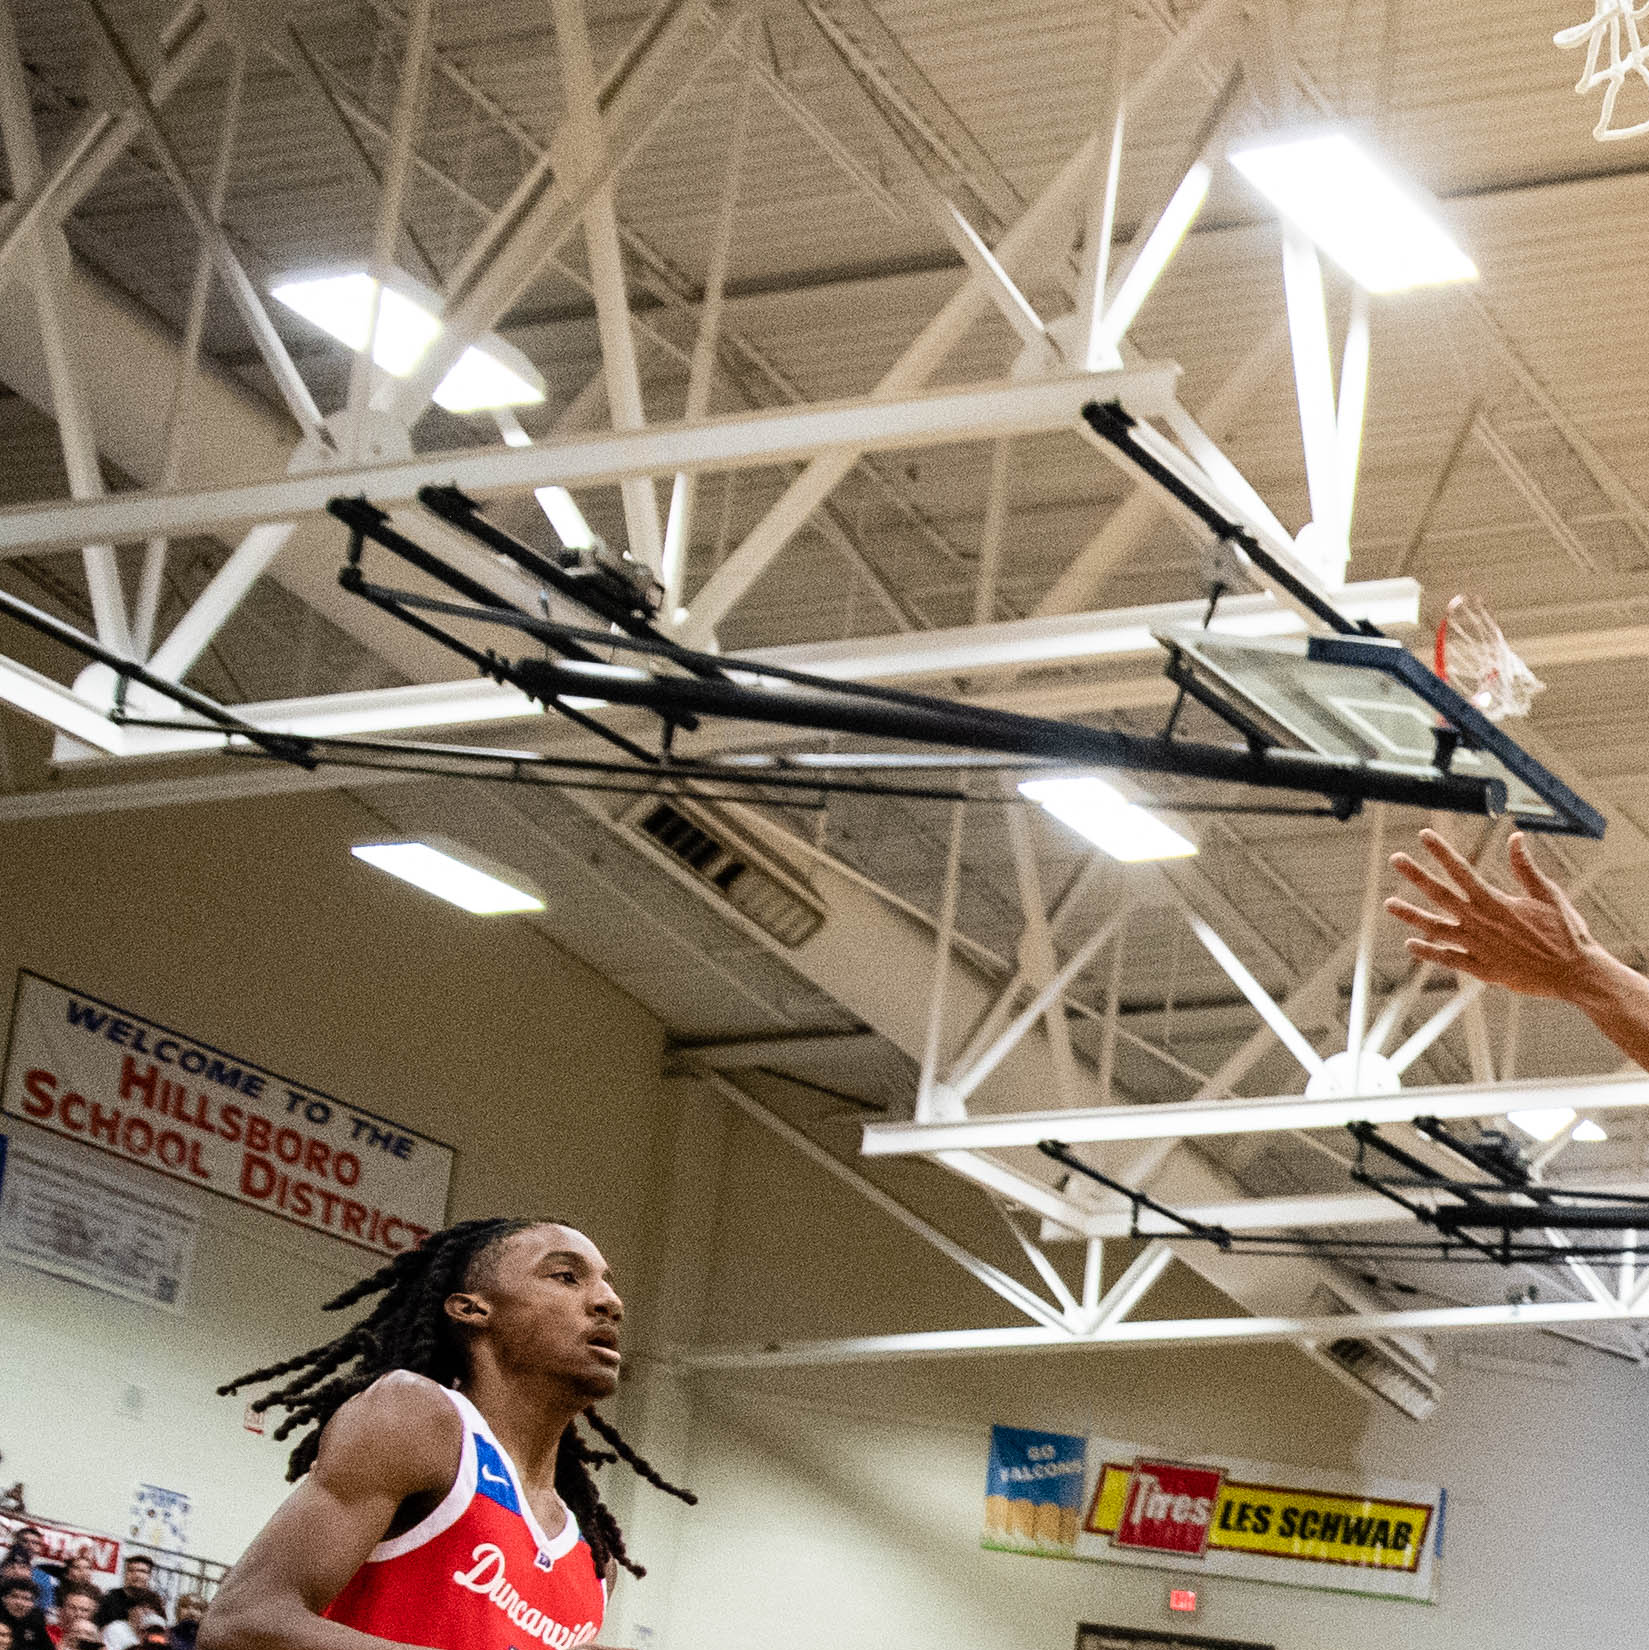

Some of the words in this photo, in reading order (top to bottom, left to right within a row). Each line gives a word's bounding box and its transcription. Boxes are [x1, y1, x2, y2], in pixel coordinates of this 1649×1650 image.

[67, 999, 267, 1098] WELCOME
[286, 1089, 333, 1125] TO
[350, 1115, 417, 1160] THE
[118, 1055, 361, 1189] HILLSBORO
[21, 1067, 210, 1178] SCHOOL
[240, 1151, 431, 1254] DISTRICT
[1131, 1473, 1210, 1526] Tires
[1219, 1499, 1272, 1535] LES
[1278, 1505, 1414, 1551] SCHWAB
